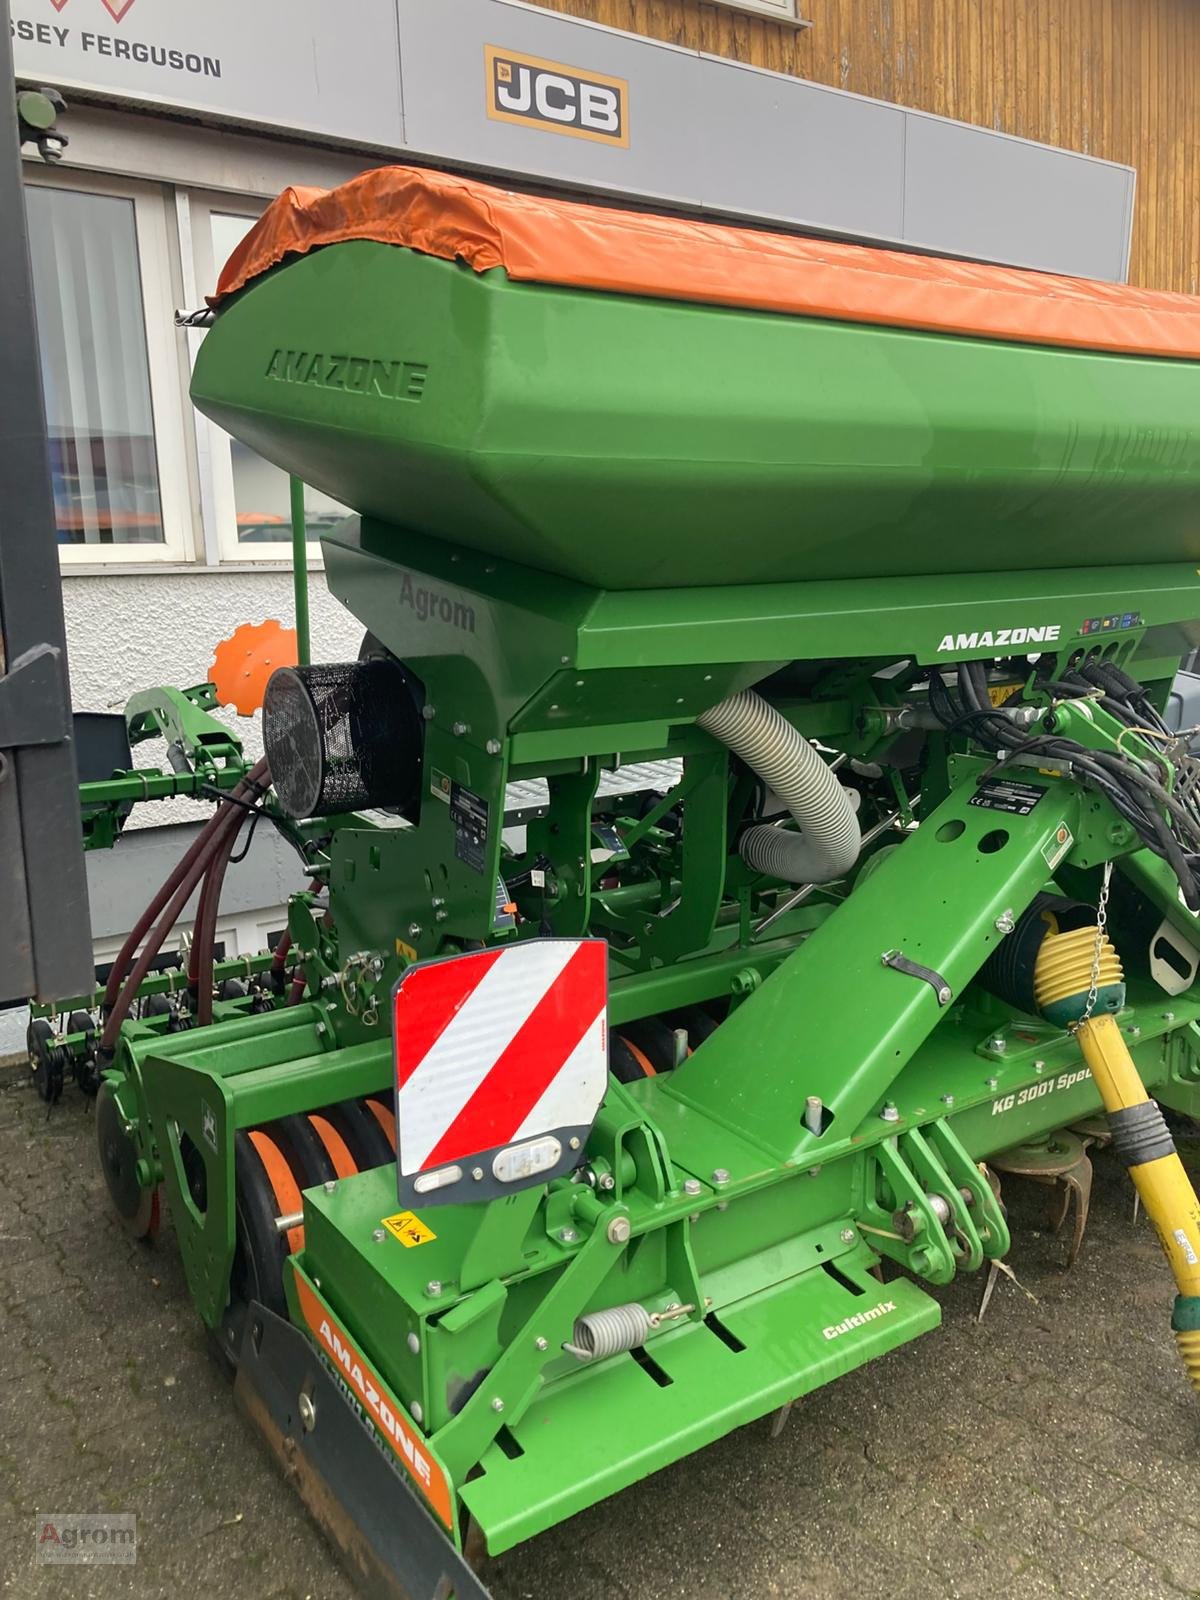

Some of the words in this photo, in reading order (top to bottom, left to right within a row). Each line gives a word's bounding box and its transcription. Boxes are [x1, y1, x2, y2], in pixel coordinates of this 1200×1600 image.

[81, 31, 222, 78] FERGUSON
[497, 67, 619, 132] JCB
[264, 349, 428, 403] AMAZONE
[400, 573, 475, 633] Agrom
[936, 625, 1061, 652] AMAZONE
[991, 1095, 1016, 1116] KG
[1017, 1079, 1055, 1105] 3001
[822, 1300, 898, 1340] Cultimix
[319, 1319, 431, 1488] AMAZONE
